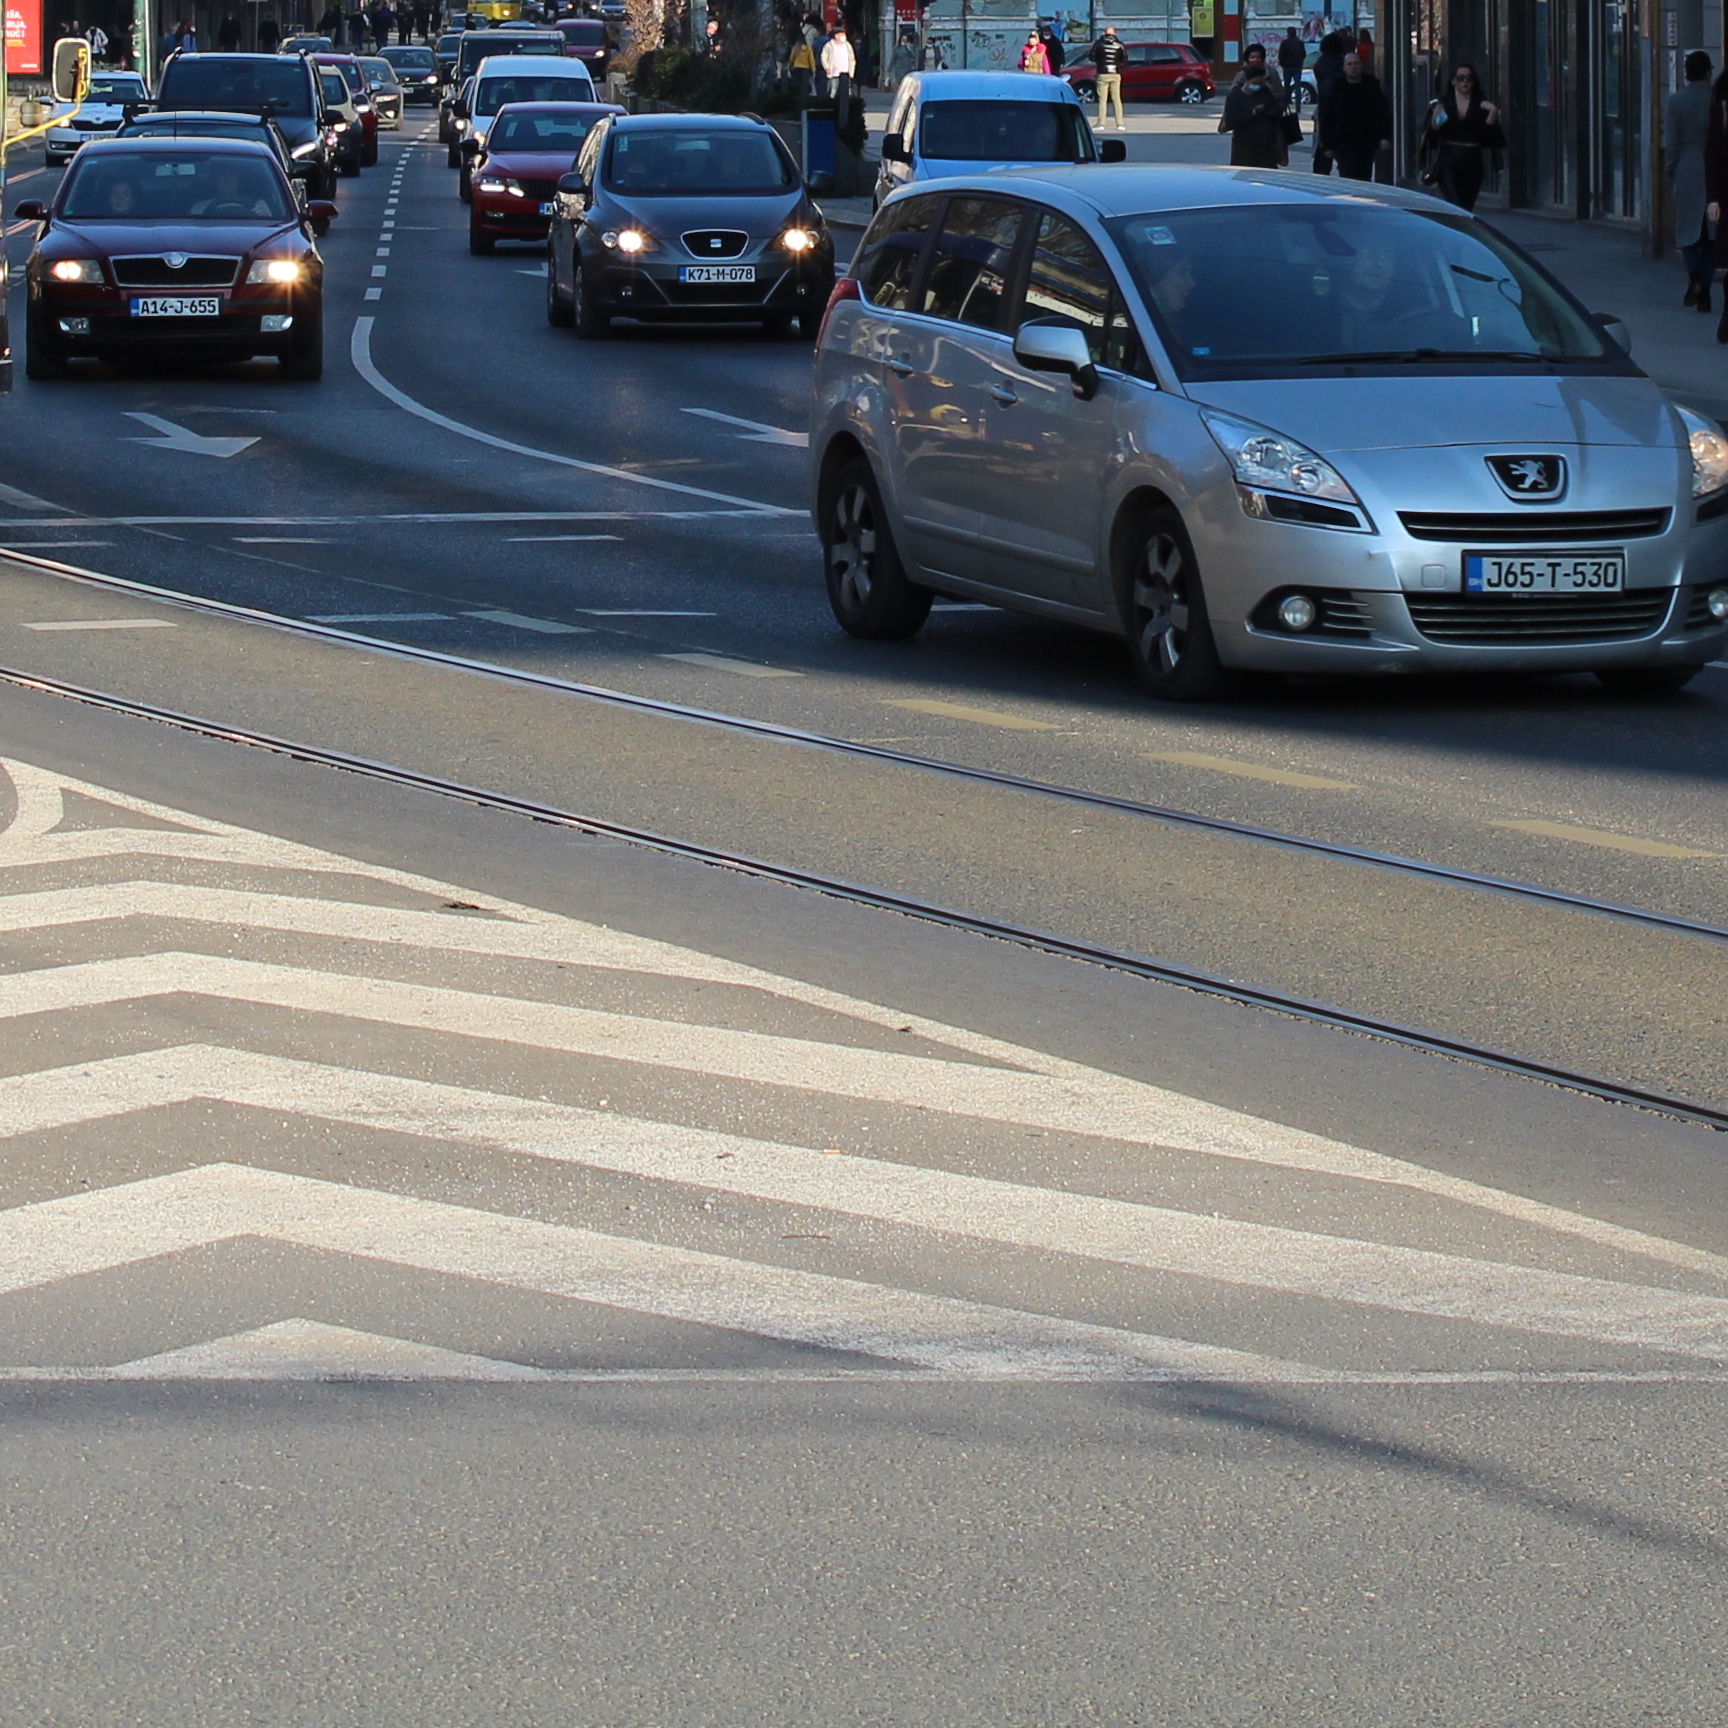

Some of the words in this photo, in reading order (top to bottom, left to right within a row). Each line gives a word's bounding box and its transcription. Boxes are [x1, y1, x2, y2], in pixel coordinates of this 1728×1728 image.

[687, 268, 754, 281] K71-M-078
[140, 299, 217, 315] A14-J-655
[1486, 561, 1618, 588] J65-T-530
